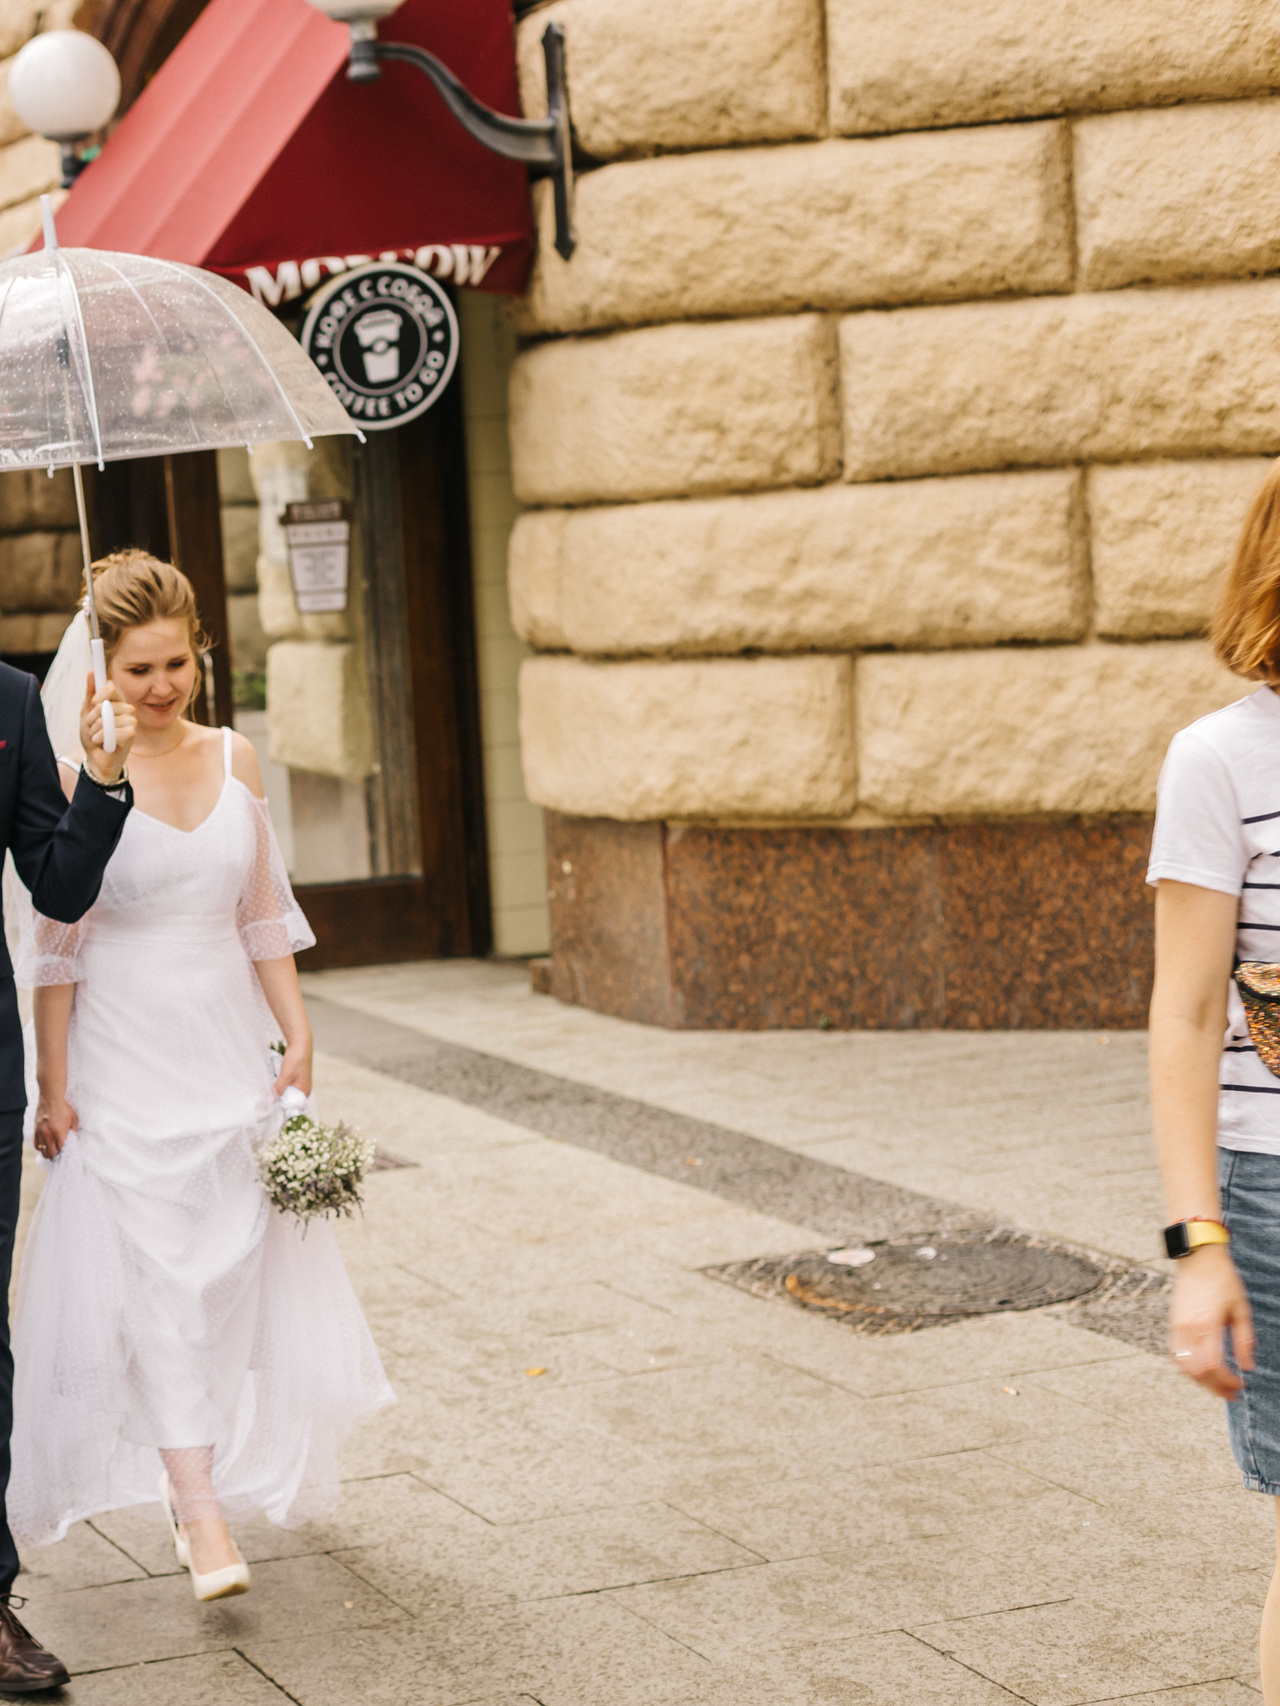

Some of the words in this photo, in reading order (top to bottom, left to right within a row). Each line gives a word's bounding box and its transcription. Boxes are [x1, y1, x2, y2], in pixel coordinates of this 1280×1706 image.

[244, 244, 502, 306] MOOW
[394, 382, 424, 410] TO
[419, 350, 446, 386] GO
